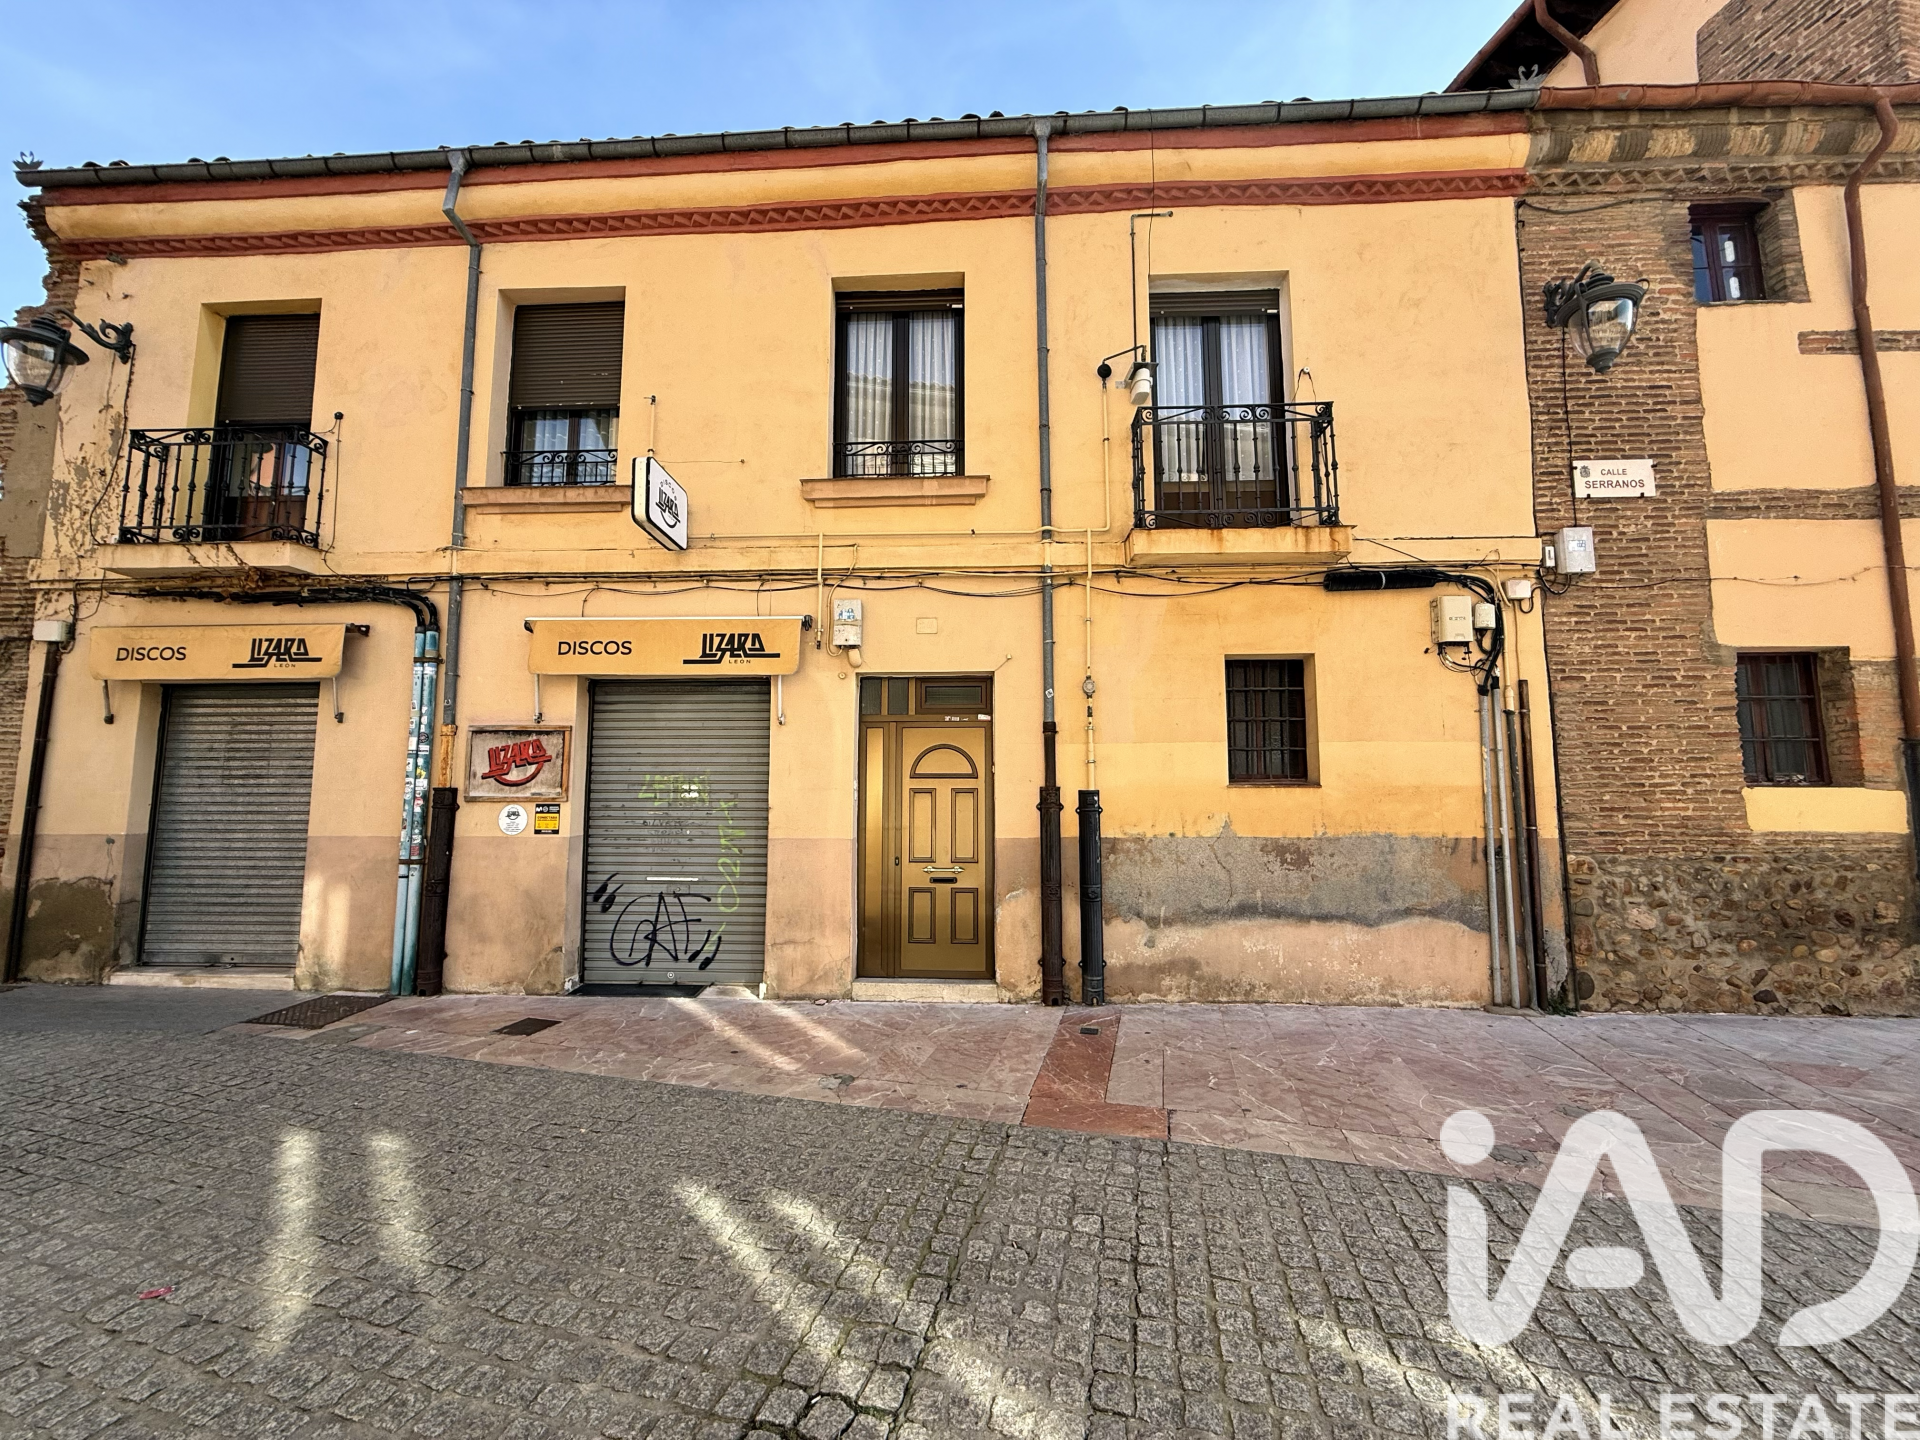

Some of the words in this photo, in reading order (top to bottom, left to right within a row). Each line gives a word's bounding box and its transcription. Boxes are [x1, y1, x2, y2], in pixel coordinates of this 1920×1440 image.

[1600, 468, 1628, 476] CALLE
[1584, 479, 1645, 489] SERRANOS
[115, 646, 187, 661] DISCOS
[232, 638, 322, 668] LIZARD
[558, 640, 633, 656] DISCOS
[683, 633, 780, 664] LIZARD
[481, 739, 552, 780] LIZARD
